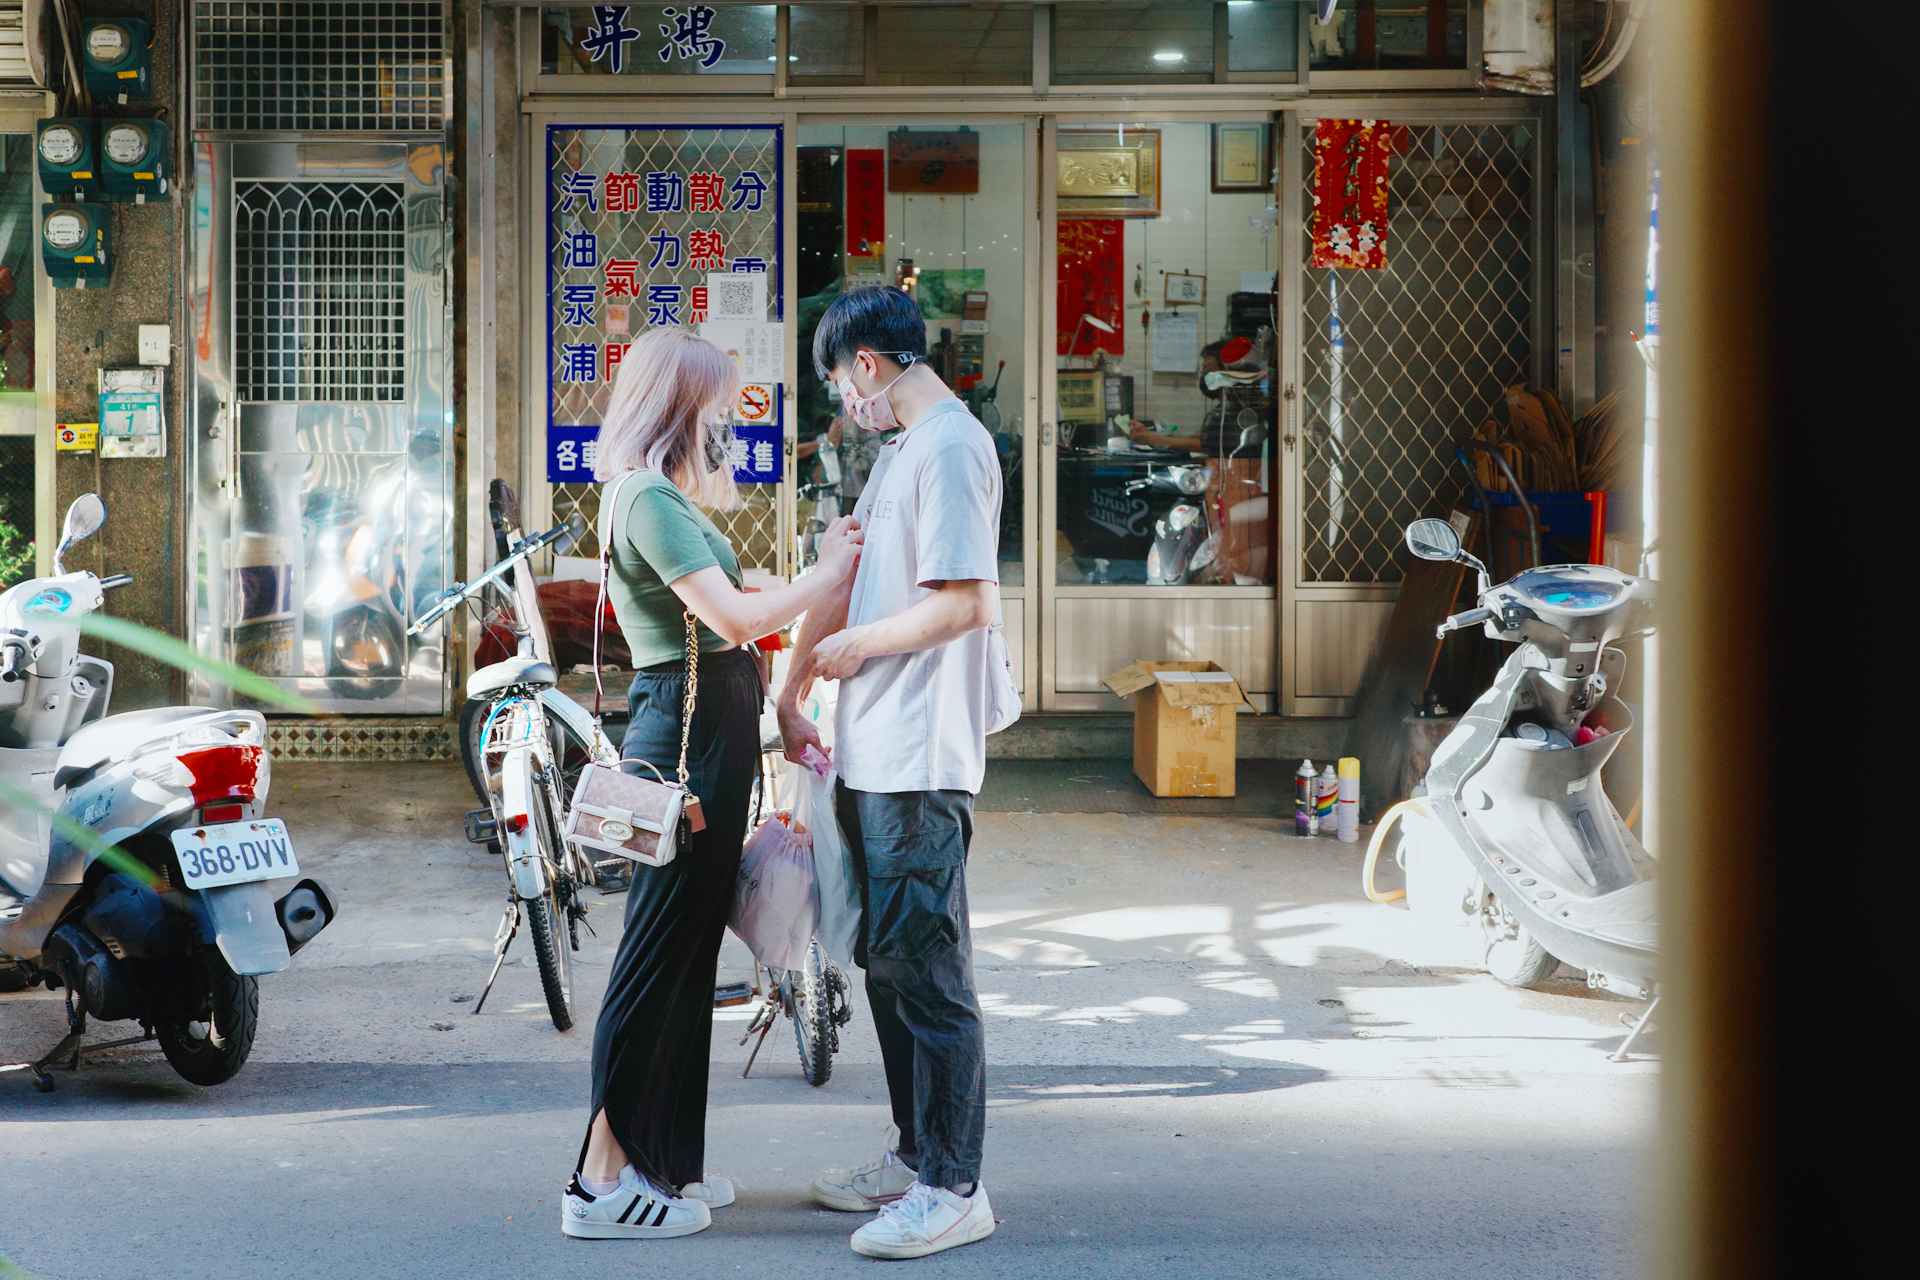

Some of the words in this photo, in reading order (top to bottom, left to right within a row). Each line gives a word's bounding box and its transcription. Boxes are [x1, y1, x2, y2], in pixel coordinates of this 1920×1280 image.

[858, 159, 873, 233] 開市大吉
[561, 170, 598, 383] 汽油泵浦
[125, 413, 134, 433] 1
[182, 837, 290, 879] 368-DVV
